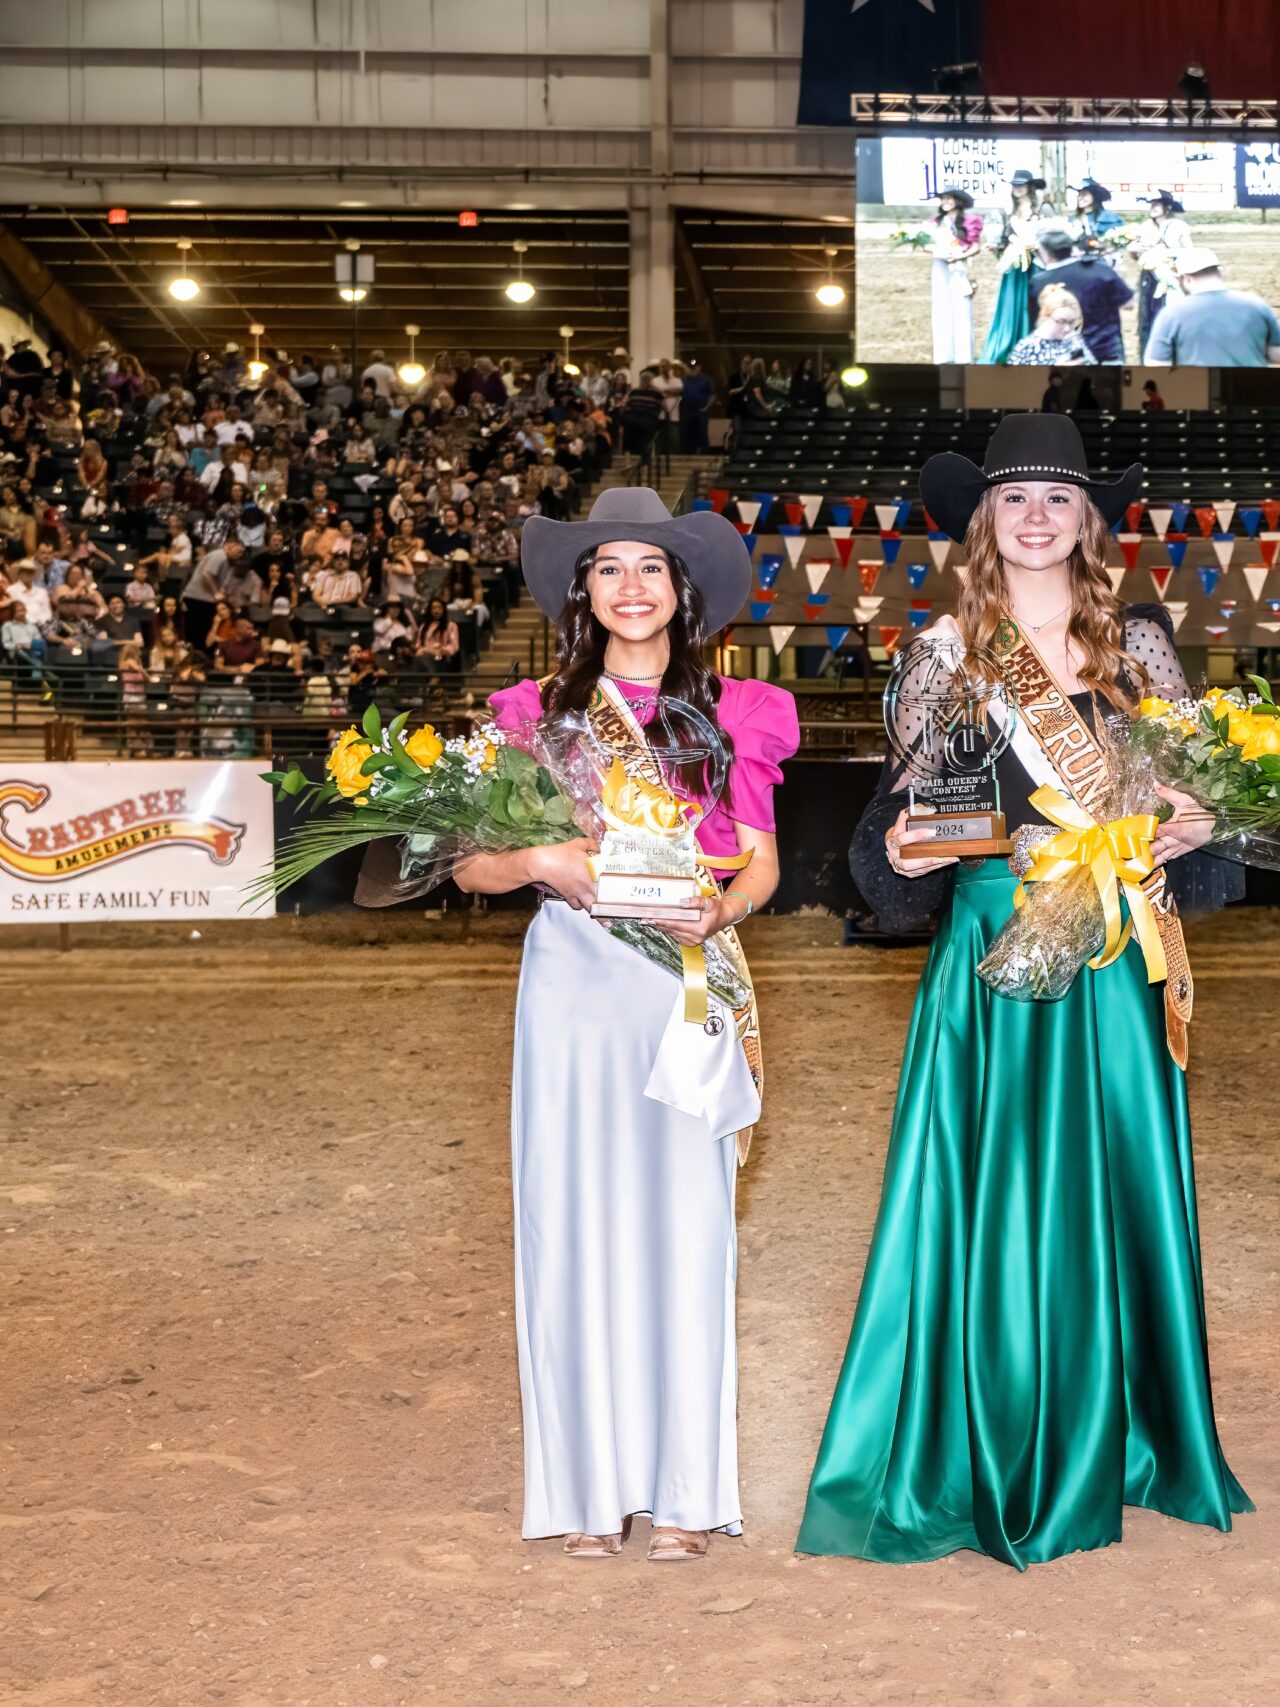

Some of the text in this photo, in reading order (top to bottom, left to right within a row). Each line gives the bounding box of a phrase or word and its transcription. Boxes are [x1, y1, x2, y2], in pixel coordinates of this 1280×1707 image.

[943, 160, 1004, 175] WELDING
[1011, 644, 1053, 699] MCFA
[947, 775, 988, 786] QUEEN'S
[933, 785, 977, 795] CONTEST
[940, 802, 993, 813] RUNNER-UP
[935, 824, 965, 836] 2024
[55, 822, 173, 871] AMUSEMENTS
[630, 886, 662, 897] 2024
[11, 889, 211, 911] SAFE FAMILY FUN
